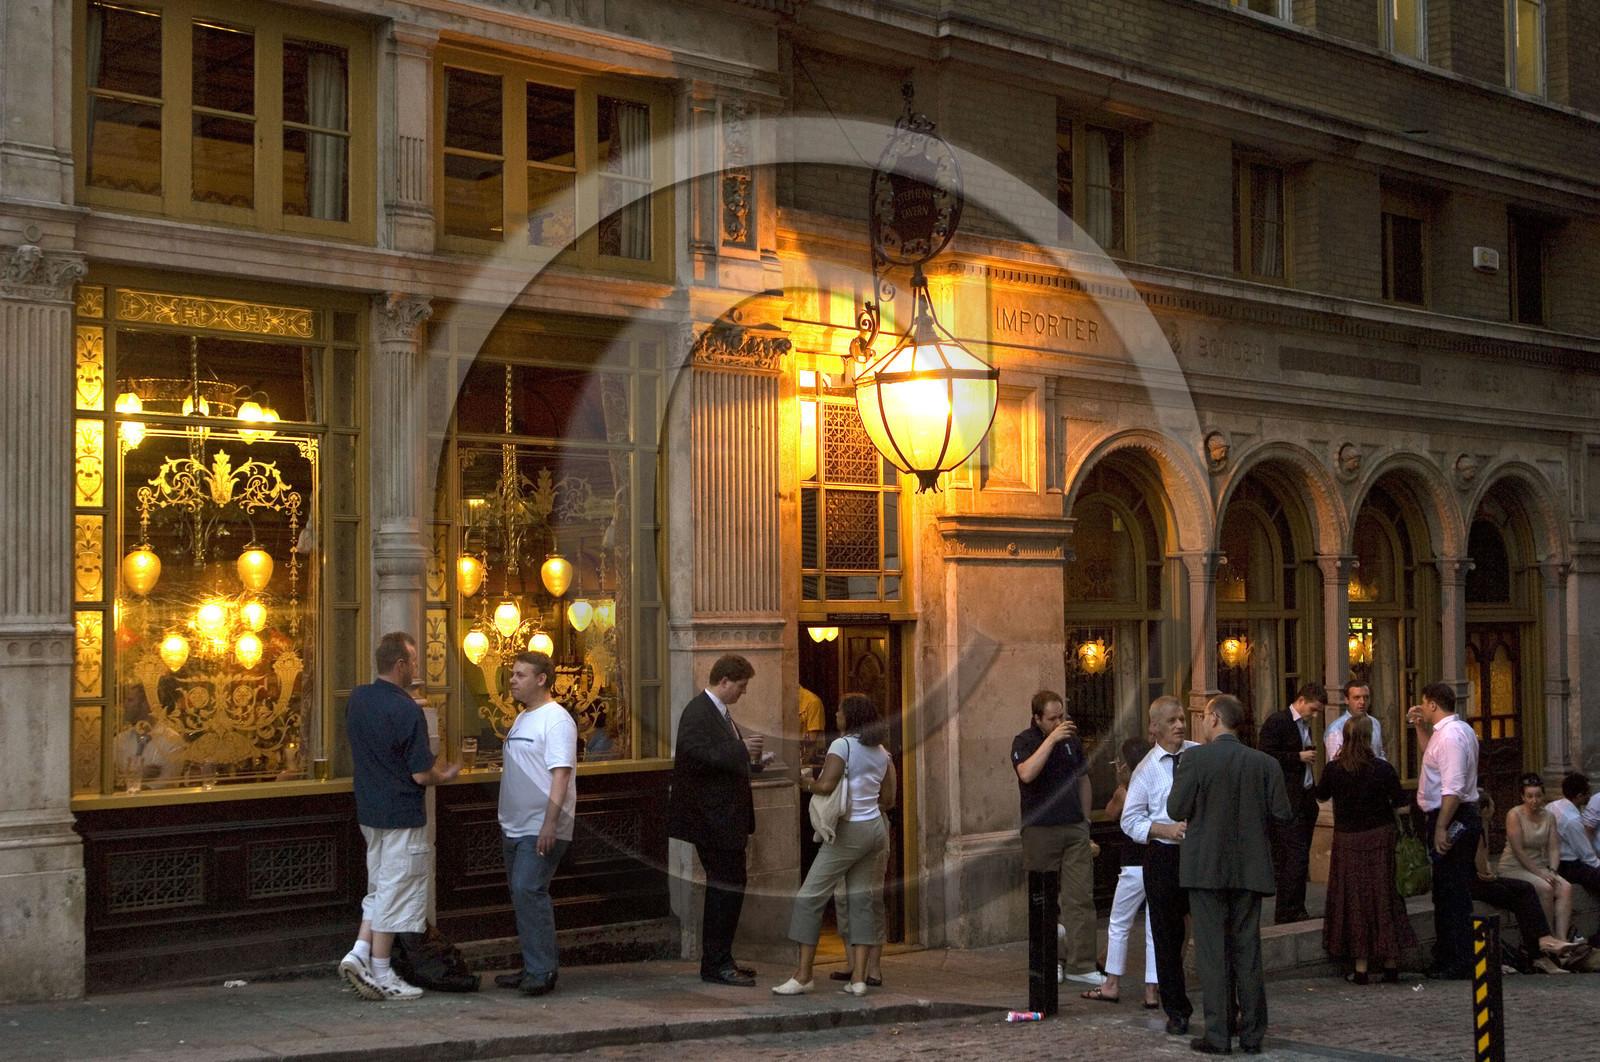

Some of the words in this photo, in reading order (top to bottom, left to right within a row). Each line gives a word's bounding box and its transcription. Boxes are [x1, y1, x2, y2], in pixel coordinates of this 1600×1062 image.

[901, 205, 929, 219] TAVERN
[996, 306, 1099, 343] IMPORTER
[1199, 335, 1265, 365] BONDER
